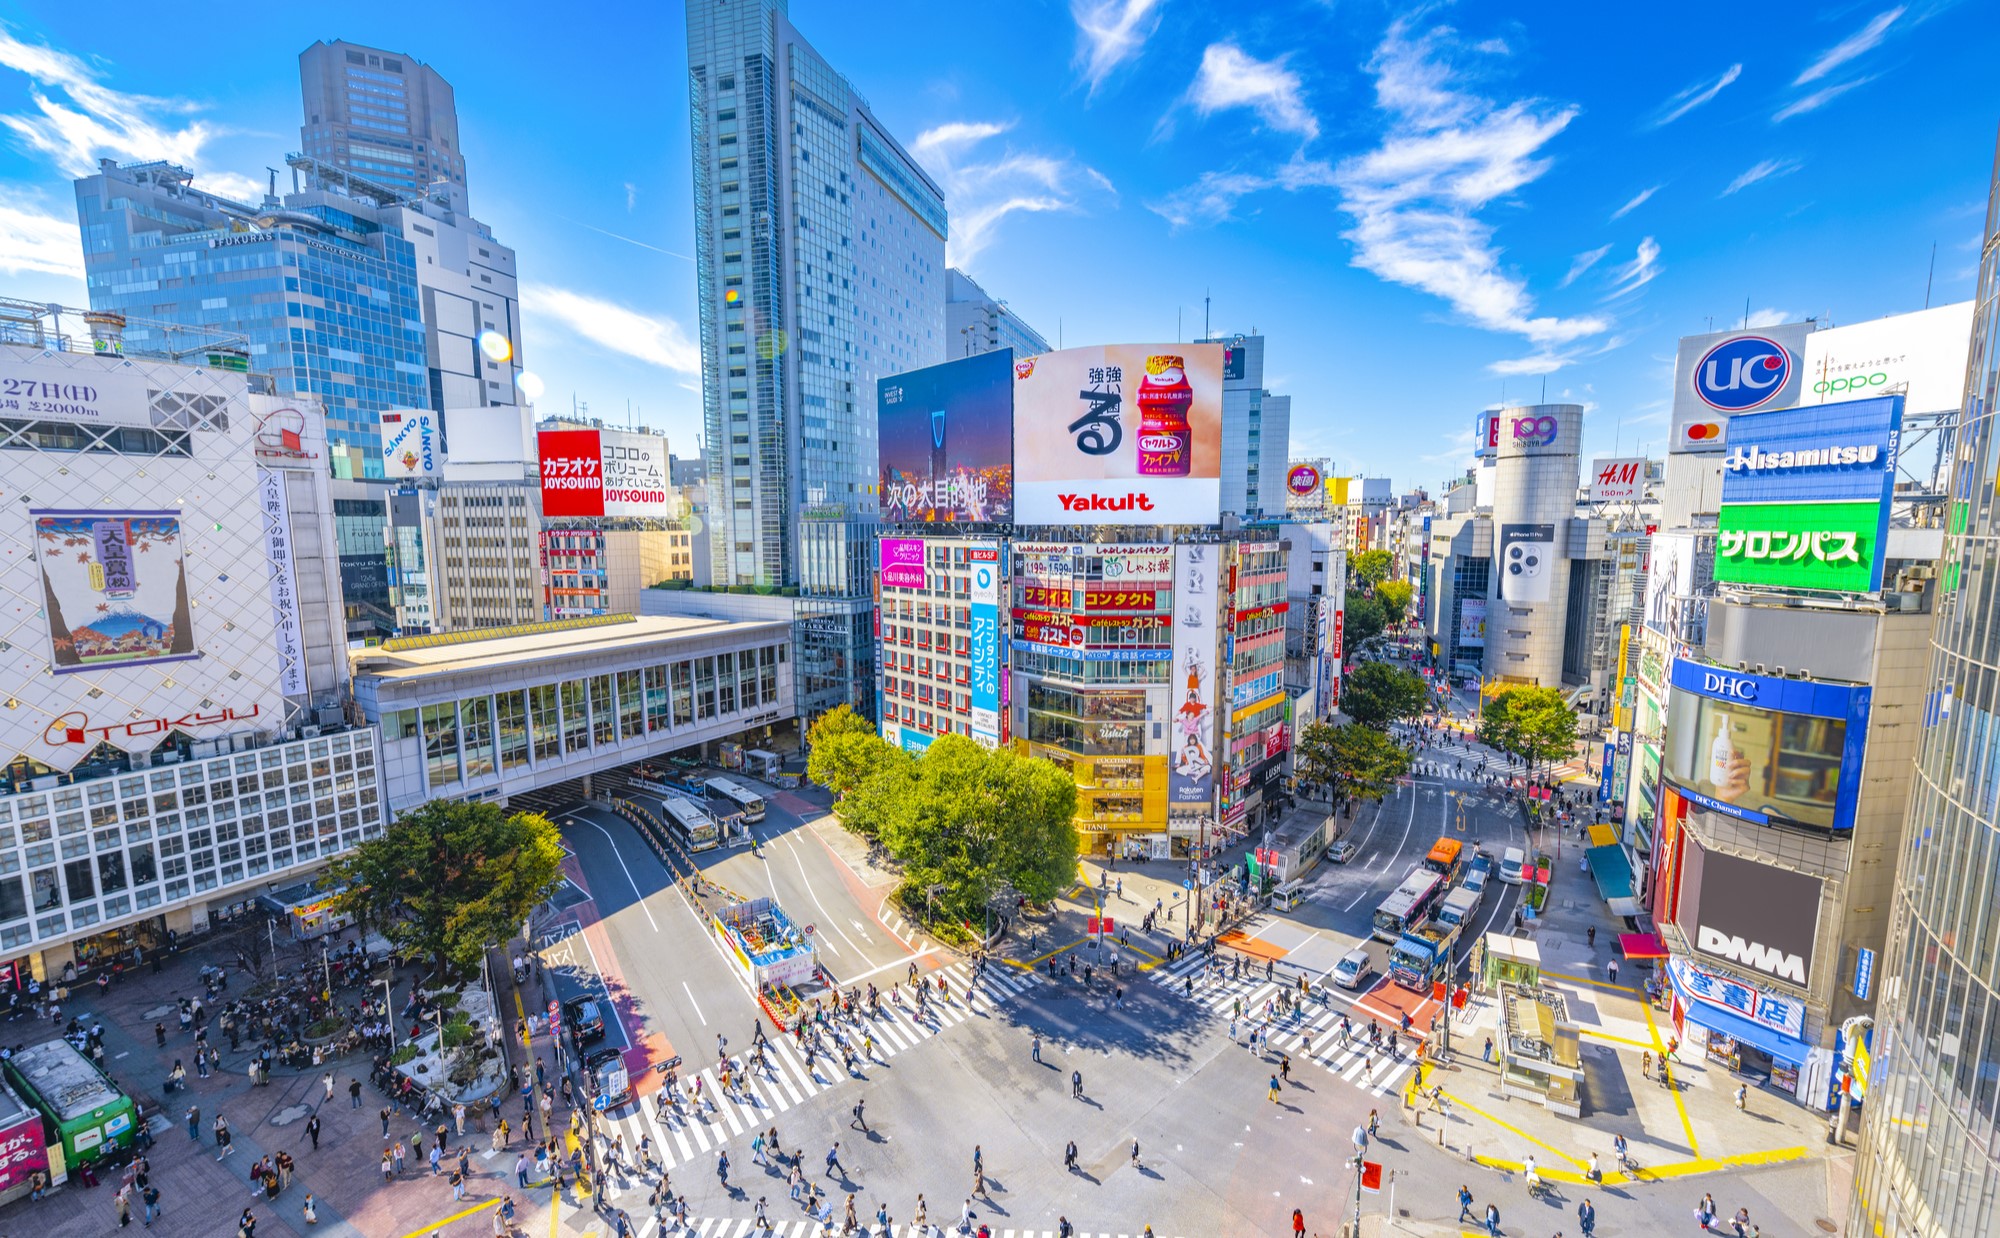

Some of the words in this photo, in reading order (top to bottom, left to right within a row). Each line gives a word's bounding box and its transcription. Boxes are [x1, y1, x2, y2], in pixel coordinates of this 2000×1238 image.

[218, 232, 274, 247] FUKURAS
[306, 239, 337, 254] TOKYU
[338, 249, 368, 263] PLAZA
[3, 378, 97, 403] 27日(日)
[1813, 373, 1887, 395] oppo
[28, 401, 99, 416] 芝2000m
[384, 418, 417, 457] SANKYO
[1511, 416, 1558, 446] 109
[420, 416, 433, 471] SANKYO
[1144, 439, 1174, 449] ヤクルト
[1512, 440, 1540, 448] SHIBUYA
[603, 445, 650, 461] ココロの
[1142, 452, 1175, 466] ファイブ
[1722, 444, 1878, 471] Hisamitsu
[1885, 430, 1899, 473] サロンパス
[543, 457, 599, 476] カラオケ
[604, 461, 663, 477] ボリューム、
[1598, 462, 1639, 486] H&M
[544, 476, 601, 490] JOYSOUND
[605, 476, 665, 489] あげていこう。
[1292, 474, 1315, 487] 楽園
[604, 489, 665, 503] JOYSOUND
[1057, 492, 1155, 512] Yakult
[1018, 545, 1069, 554] しゃぶしゃぶバイキング
[1096, 546, 1170, 555] しゃぶしゃぶバイキング
[1720, 530, 1860, 562] サロンパス
[101, 529, 130, 588] 天皇賞(秋)
[900, 553, 920, 561] クリニック
[1015, 560, 1023, 568] 9F
[1127, 559, 1171, 574] しゃぶ葉
[888, 571, 922, 584] 品川美容外科
[974, 591, 994, 599] eyecity
[1026, 589, 1071, 603] プライス
[1086, 592, 1153, 606] コンタクト
[1051, 613, 1074, 626] ガスト
[1132, 617, 1163, 629] ガスト
[1015, 625, 1024, 634] 7F
[1040, 626, 1067, 643] ガスト
[974, 617, 984, 692] アイシティ
[986, 618, 995, 695] コンタクトの
[1112, 651, 1171, 660] 英会話イーオン
[1704, 672, 1759, 700] DHC
[89, 704, 260, 740] TOKYU
[1265, 763, 1281, 780] LUSH
[1179, 786, 1204, 795] Rakuten
[1695, 795, 1711, 805] DHC
[1711, 801, 1742, 816] Channel
[1697, 925, 1806, 985] DMM
